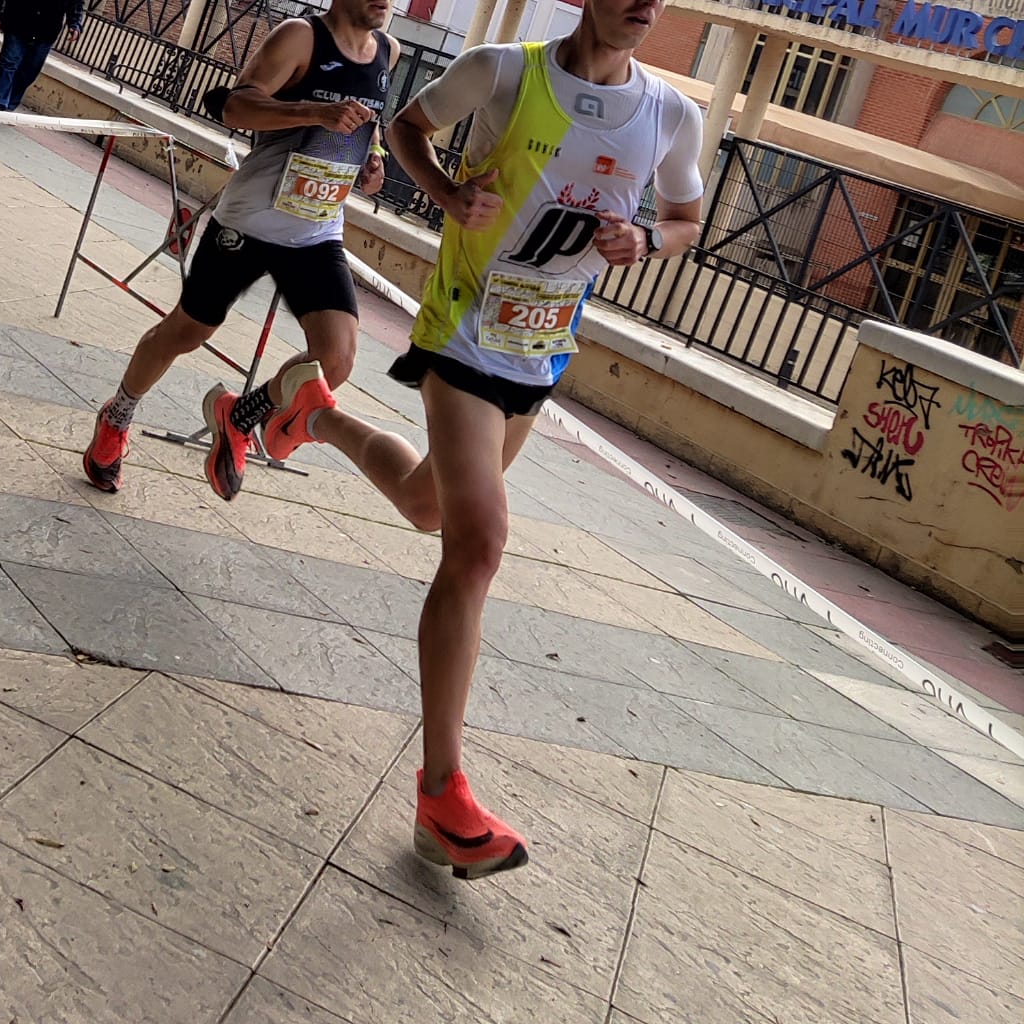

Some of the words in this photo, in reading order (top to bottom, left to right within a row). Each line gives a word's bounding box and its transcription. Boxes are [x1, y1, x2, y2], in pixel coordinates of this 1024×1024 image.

[313, 89, 341, 102] CLUB
[303, 180, 340, 202] 092
[508, 304, 560, 330] 205
[717, 530, 756, 565] Connecting
[858, 630, 904, 670] Connecting
